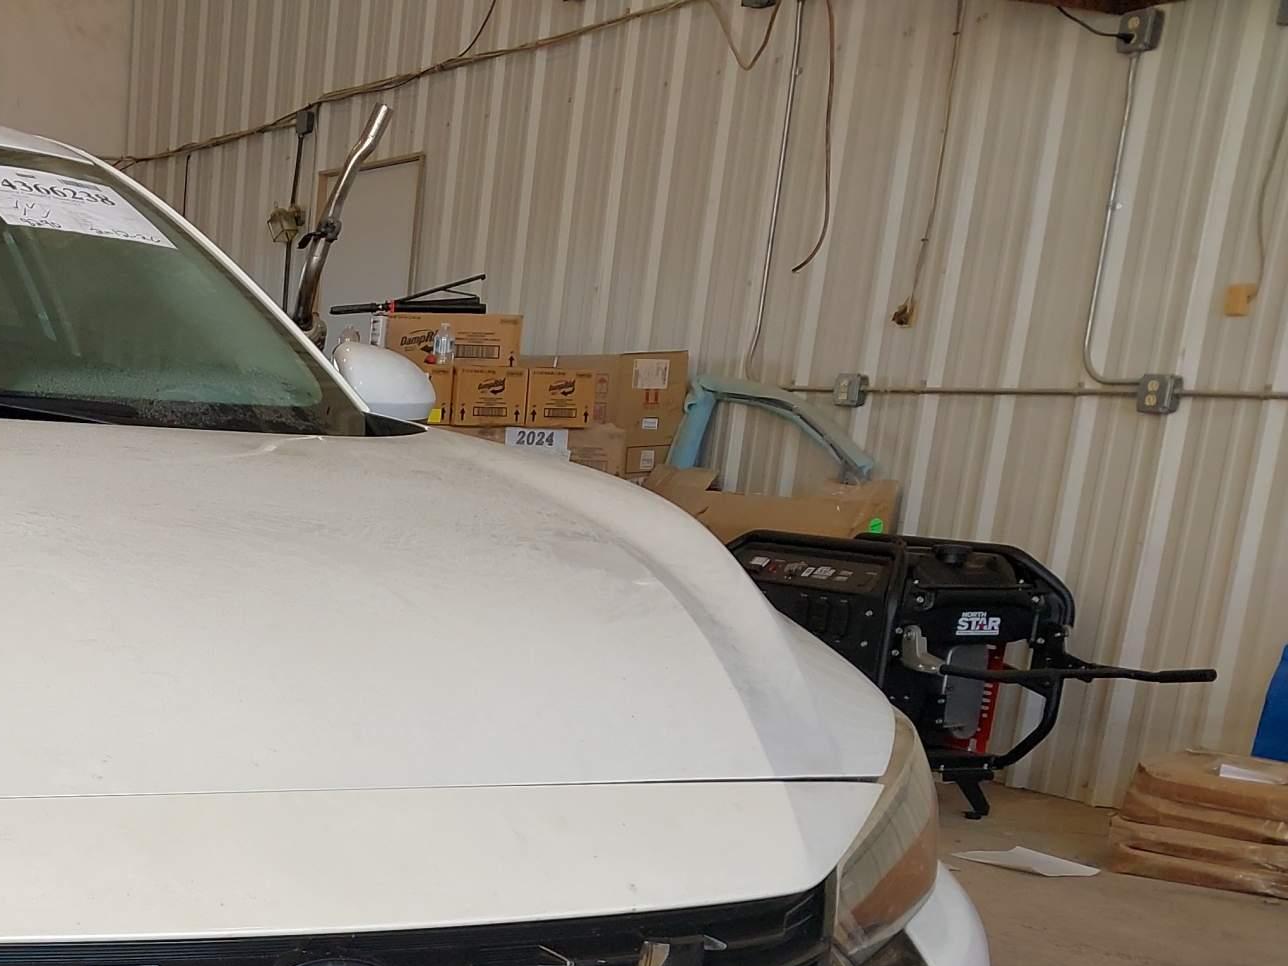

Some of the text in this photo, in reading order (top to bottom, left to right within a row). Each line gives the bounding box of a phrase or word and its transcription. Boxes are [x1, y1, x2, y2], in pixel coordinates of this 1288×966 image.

[400, 329, 439, 346] DampRi
[516, 430, 555, 446] 2024
[956, 617, 1001, 631] STAR
